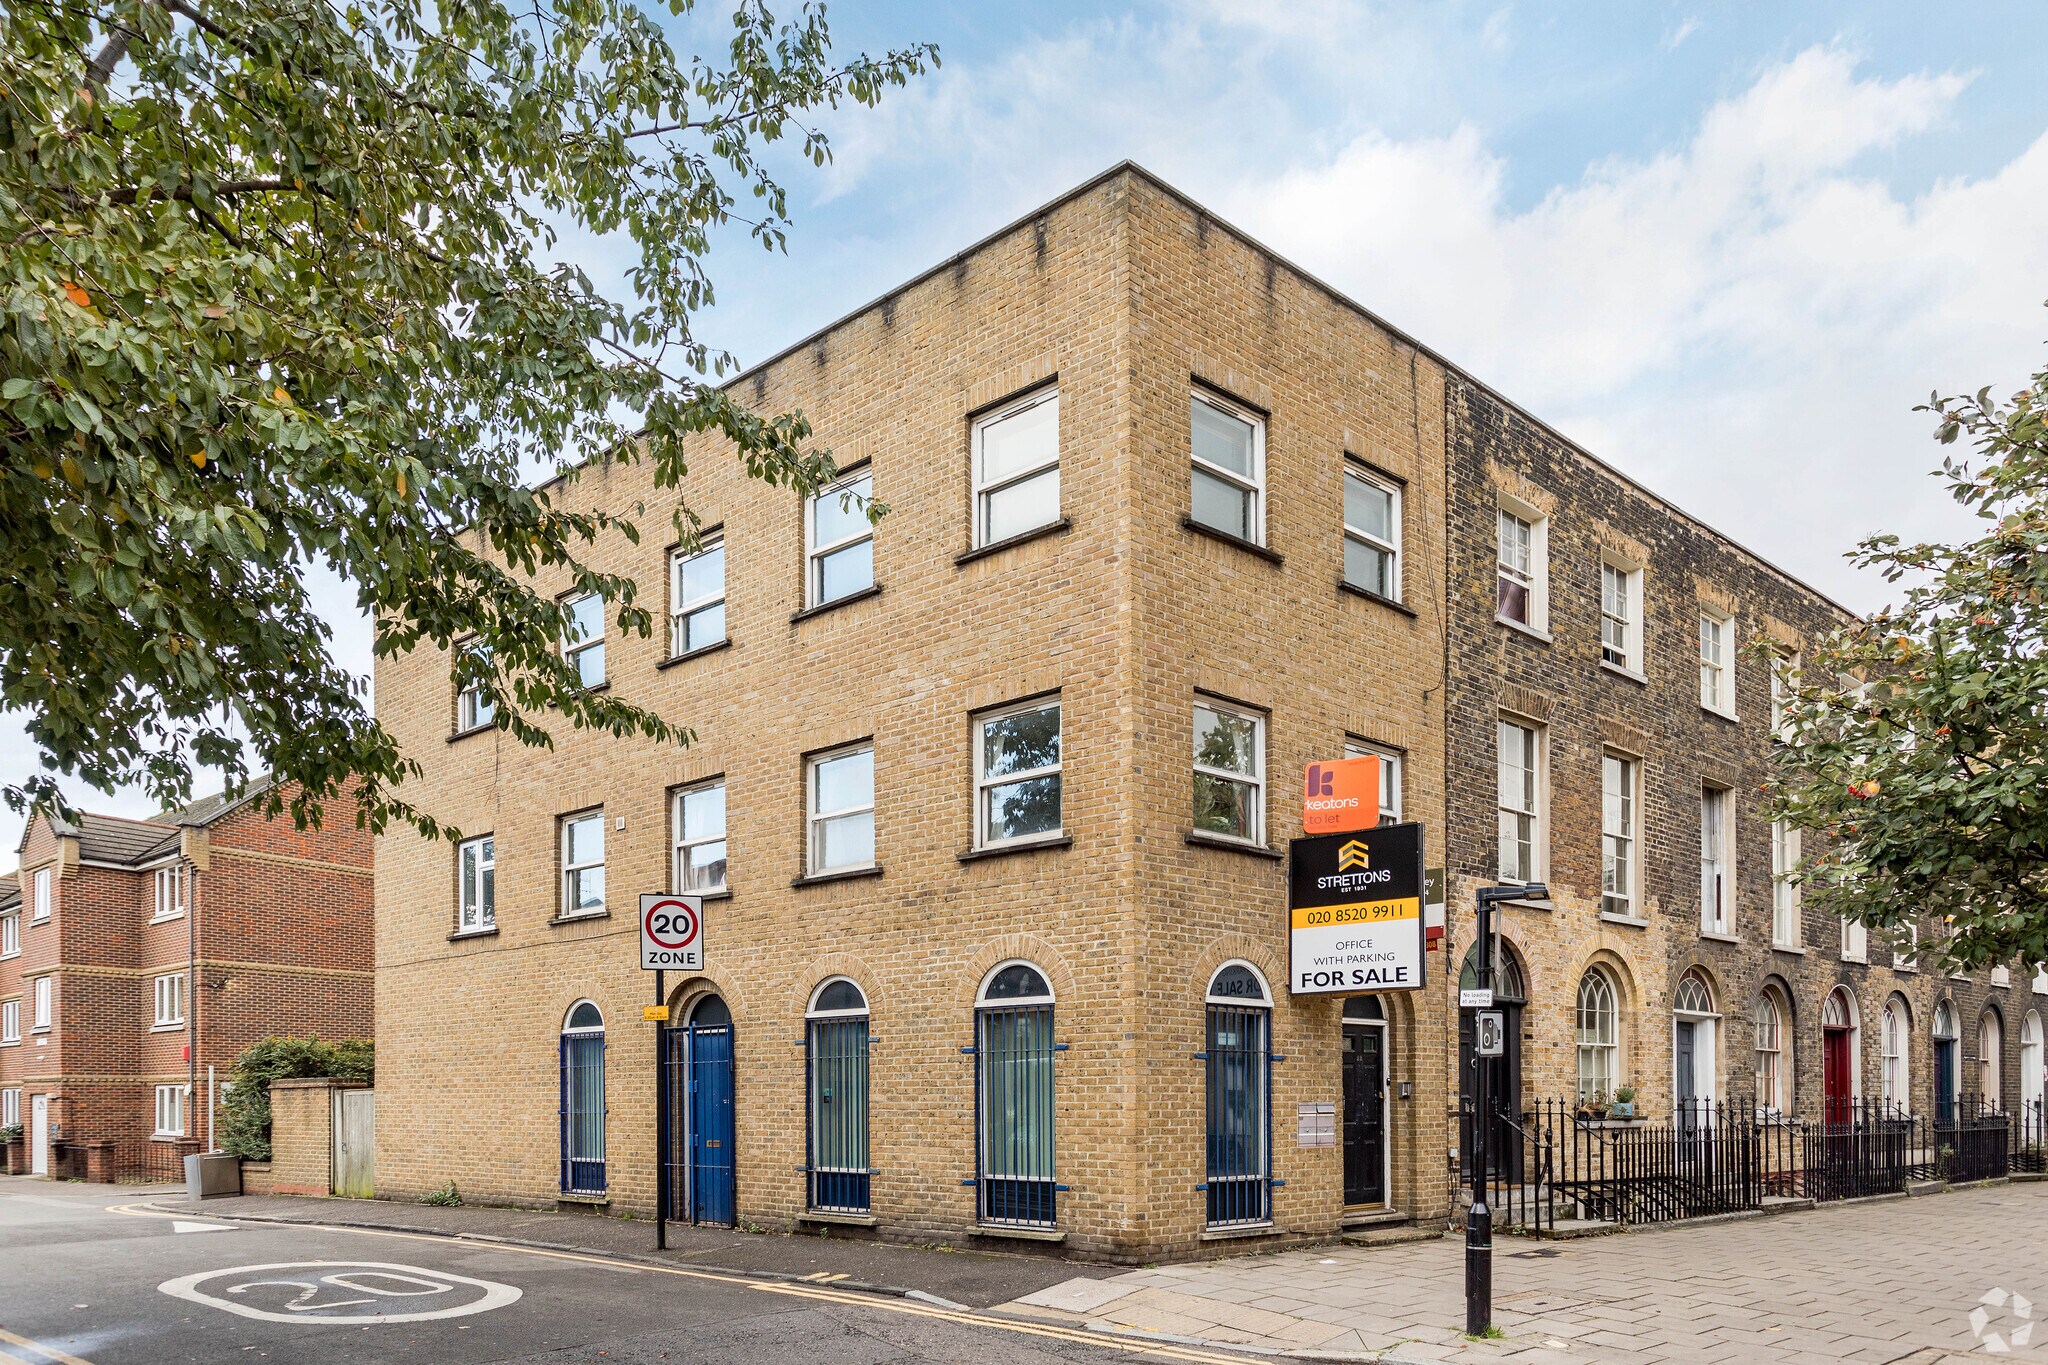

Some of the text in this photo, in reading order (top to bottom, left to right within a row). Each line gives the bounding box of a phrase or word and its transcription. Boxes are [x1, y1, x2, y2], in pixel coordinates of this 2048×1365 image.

[1306, 797, 1359, 811] keatons
[1309, 813, 1340, 825] to let
[1317, 869, 1391, 889] STRETTONS
[1424, 878, 1435, 887] ey
[1307, 904, 1403, 925] 020 8520 9911
[654, 914, 690, 935] 20
[1335, 939, 1373, 950] OFFICE
[648, 951, 696, 964] ZONE
[1313, 952, 1395, 966] WITH PARKING
[1301, 966, 1408, 988] FOR SALE
[225, 1271, 454, 1311] 20
